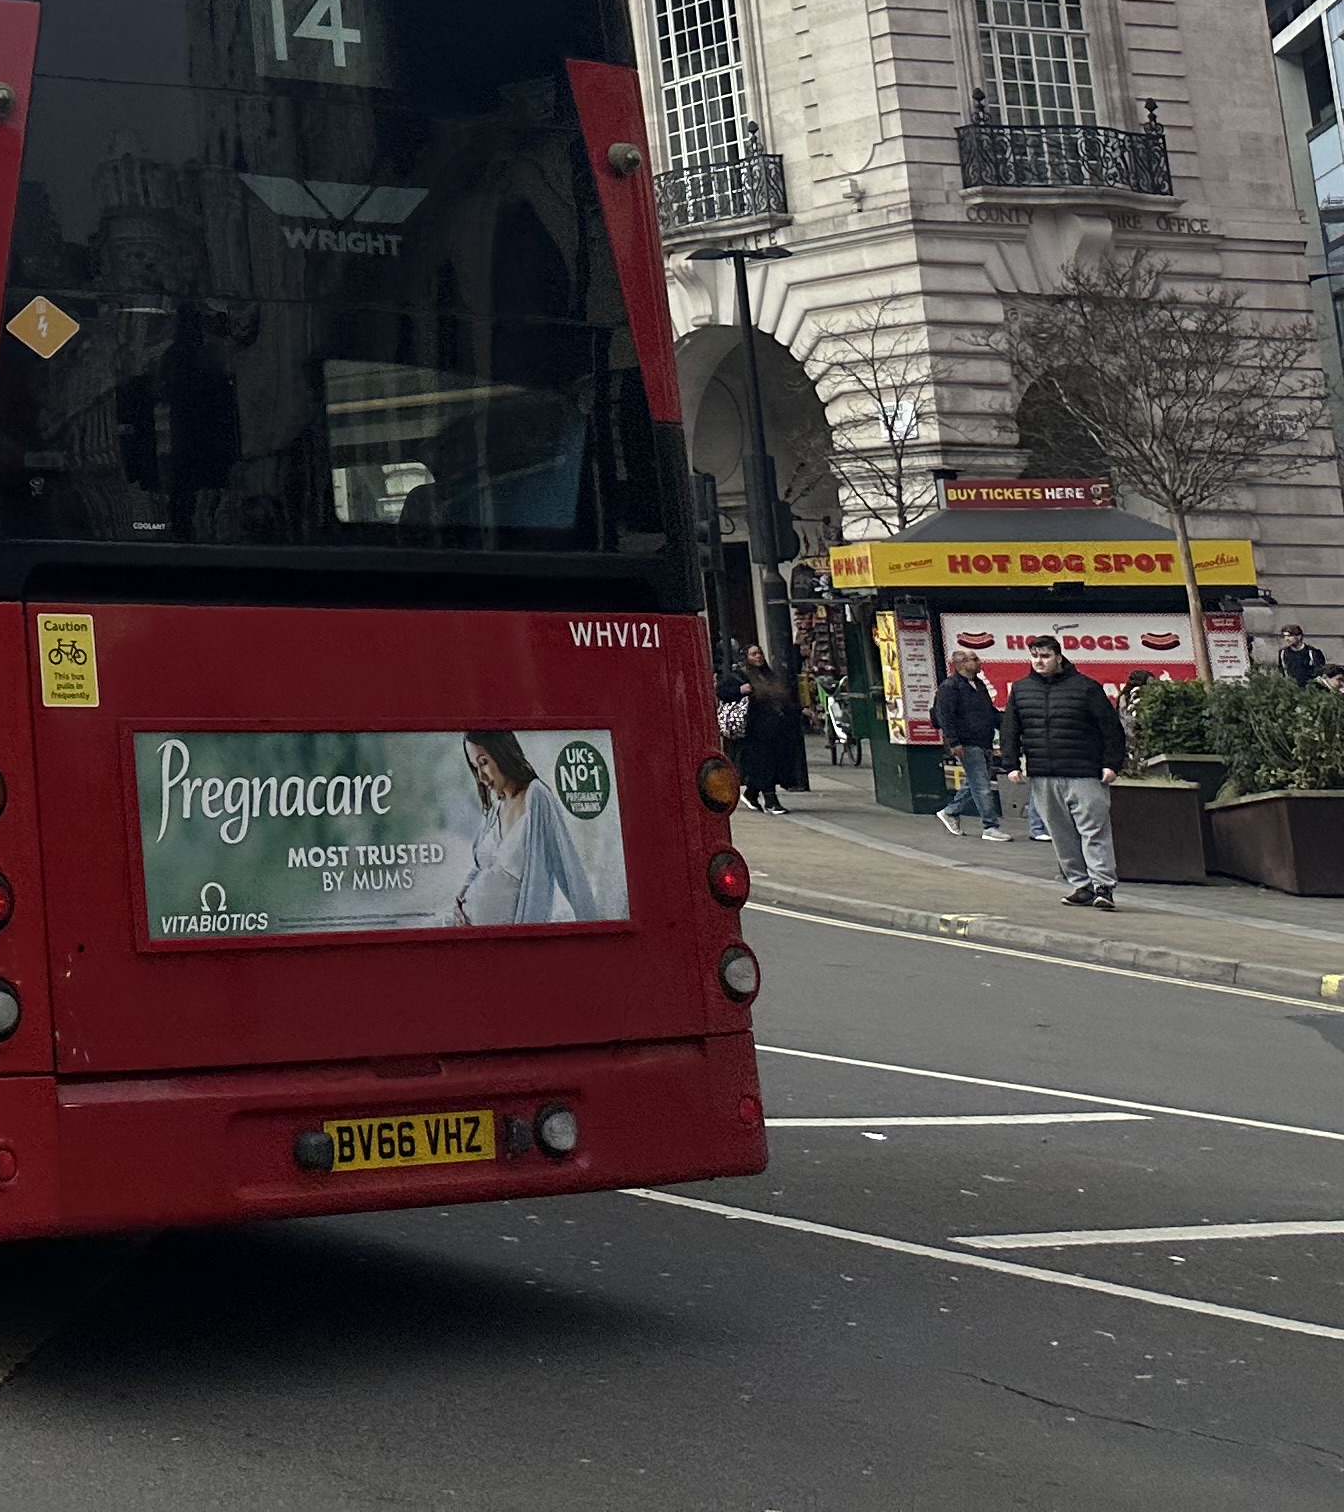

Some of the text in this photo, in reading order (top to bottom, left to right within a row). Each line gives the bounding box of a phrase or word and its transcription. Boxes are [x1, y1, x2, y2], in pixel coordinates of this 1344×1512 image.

[966, 206, 1034, 224] COUNTY
[1157, 217, 1212, 234] OFFICE
[280, 226, 403, 256] WRIGHT
[946, 486, 1085, 501] BUY TICKETS HERE
[946, 553, 1175, 574] HOT DOG SPOT
[44, 620, 88, 632] Caution
[568, 621, 660, 648] WHV121
[1063, 635, 1130, 651] DOGS
[54, 671, 85, 681] This bus
[51, 691, 90, 701] frequently
[57, 682, 73, 692] pulls
[566, 748, 594, 765] UK's
[288, 842, 445, 868] MOST TRUSTED
[323, 868, 413, 892] BY MUMS
[162, 912, 269, 933] VITABIOTICS
[336, 1115, 483, 1164] BV66 VHZ
